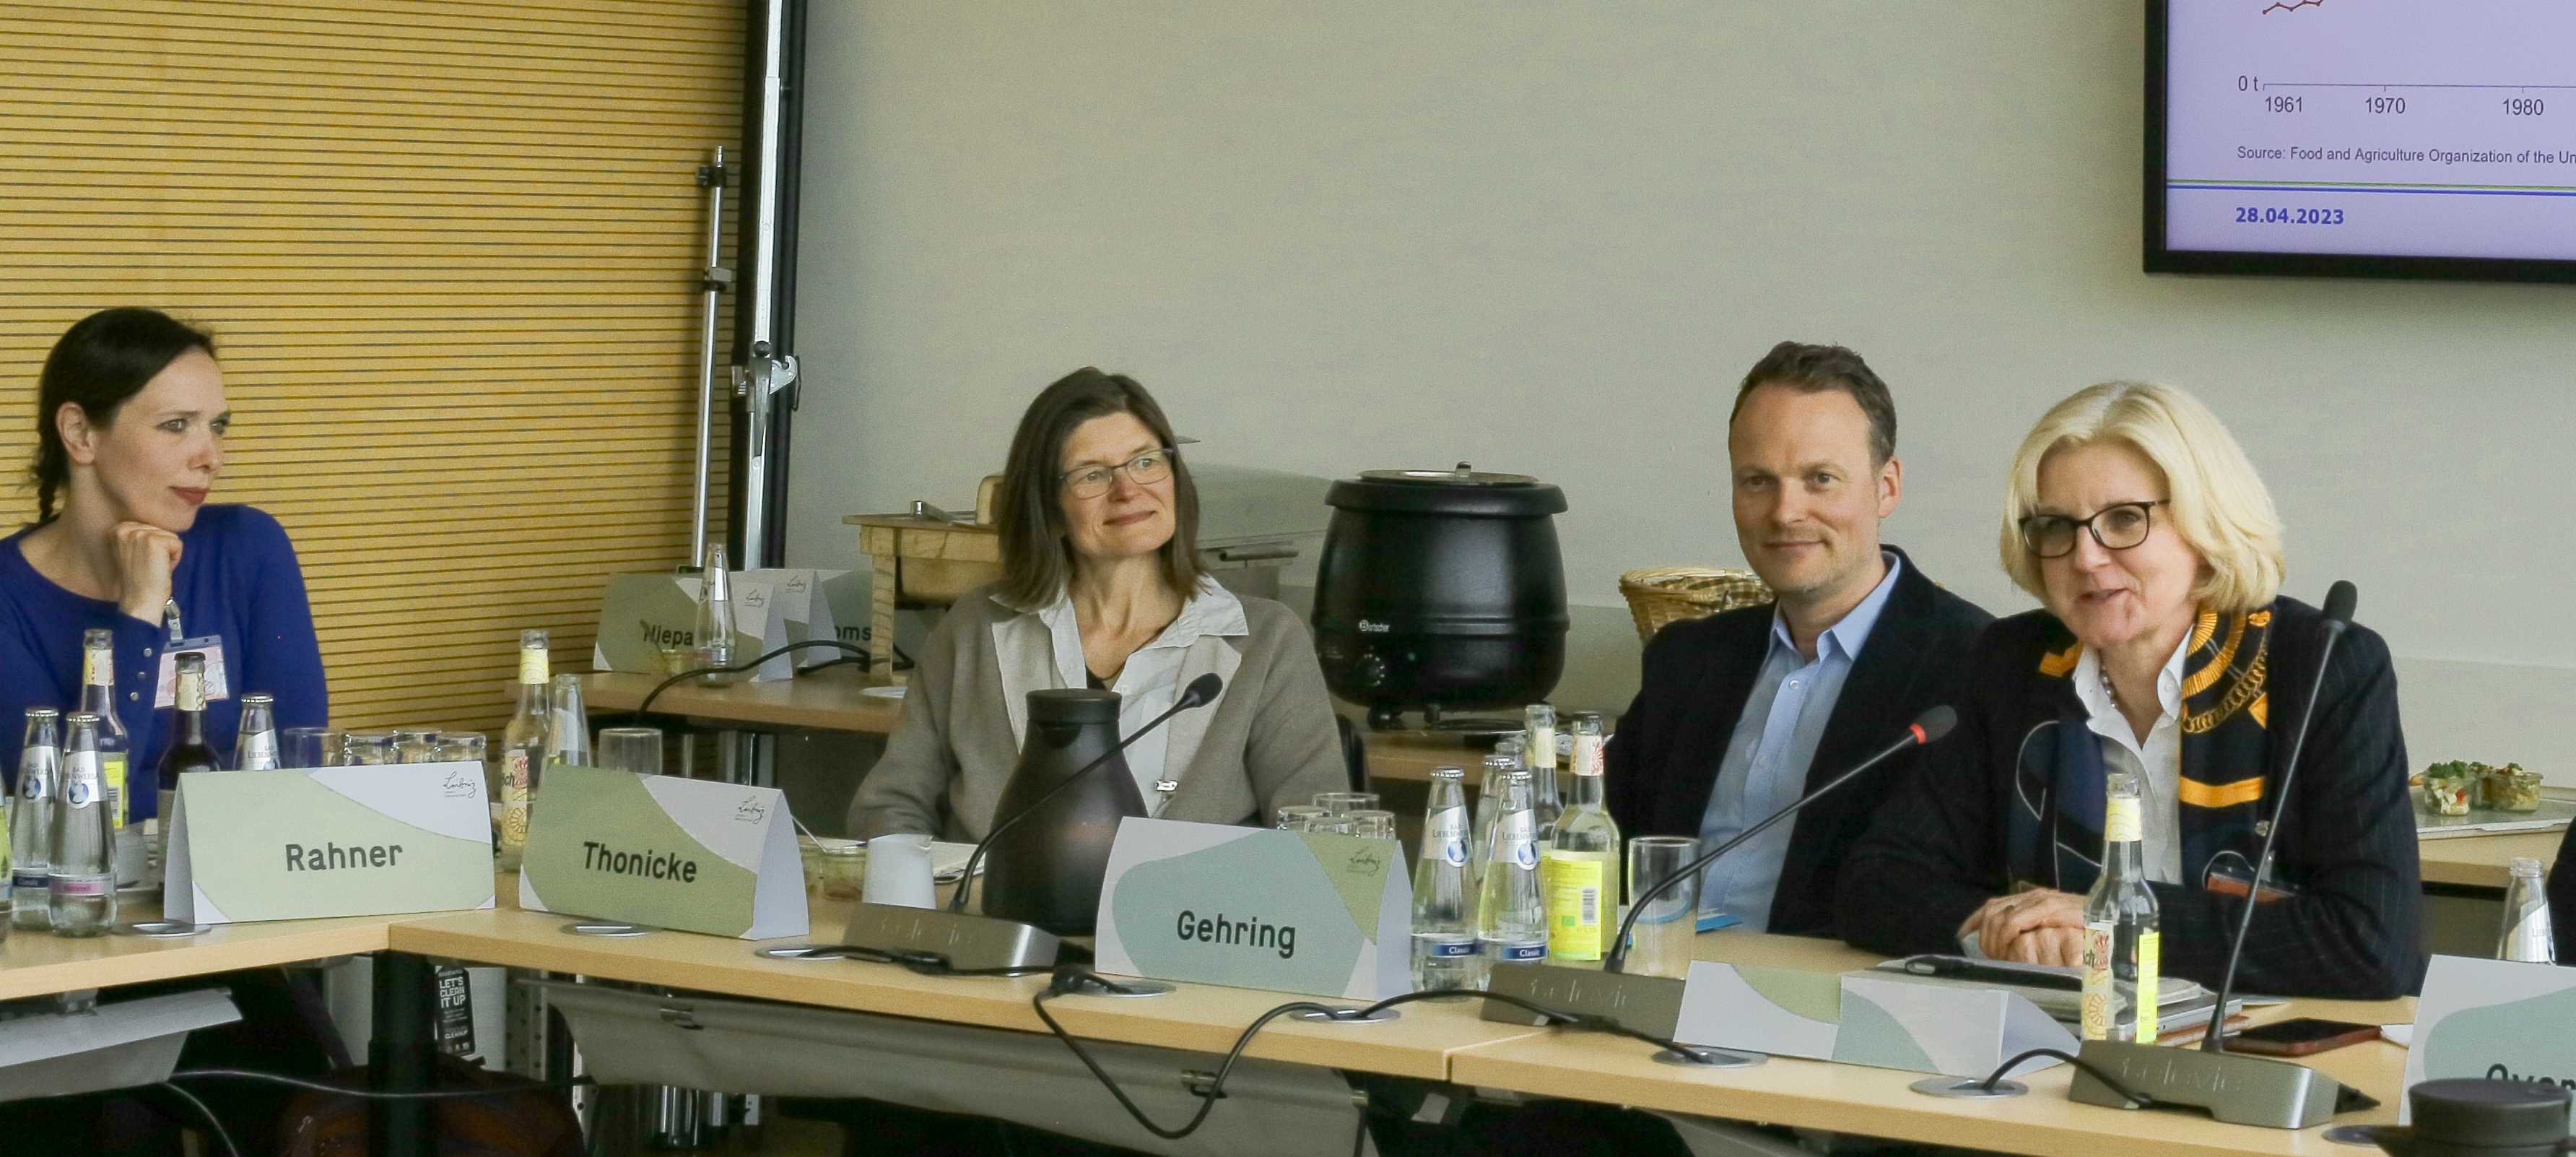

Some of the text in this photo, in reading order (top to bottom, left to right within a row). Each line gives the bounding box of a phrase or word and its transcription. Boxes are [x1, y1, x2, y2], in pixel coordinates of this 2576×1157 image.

[2238, 75, 2259, 91] 0 t
[2266, 96, 2544, 116] 1961 1970 1980
[2237, 146, 2576, 165] Source: Food and Agriculture Organization of the Un
[2235, 207, 2344, 225] 28.04.2023
[643, 625, 694, 650] Niepa
[834, 625, 872, 641] oms
[286, 841, 404, 872] Rahner
[583, 841, 697, 884] Thonicke
[1177, 910, 1296, 960] Gehring
[440, 994, 466, 1008] IT UP
